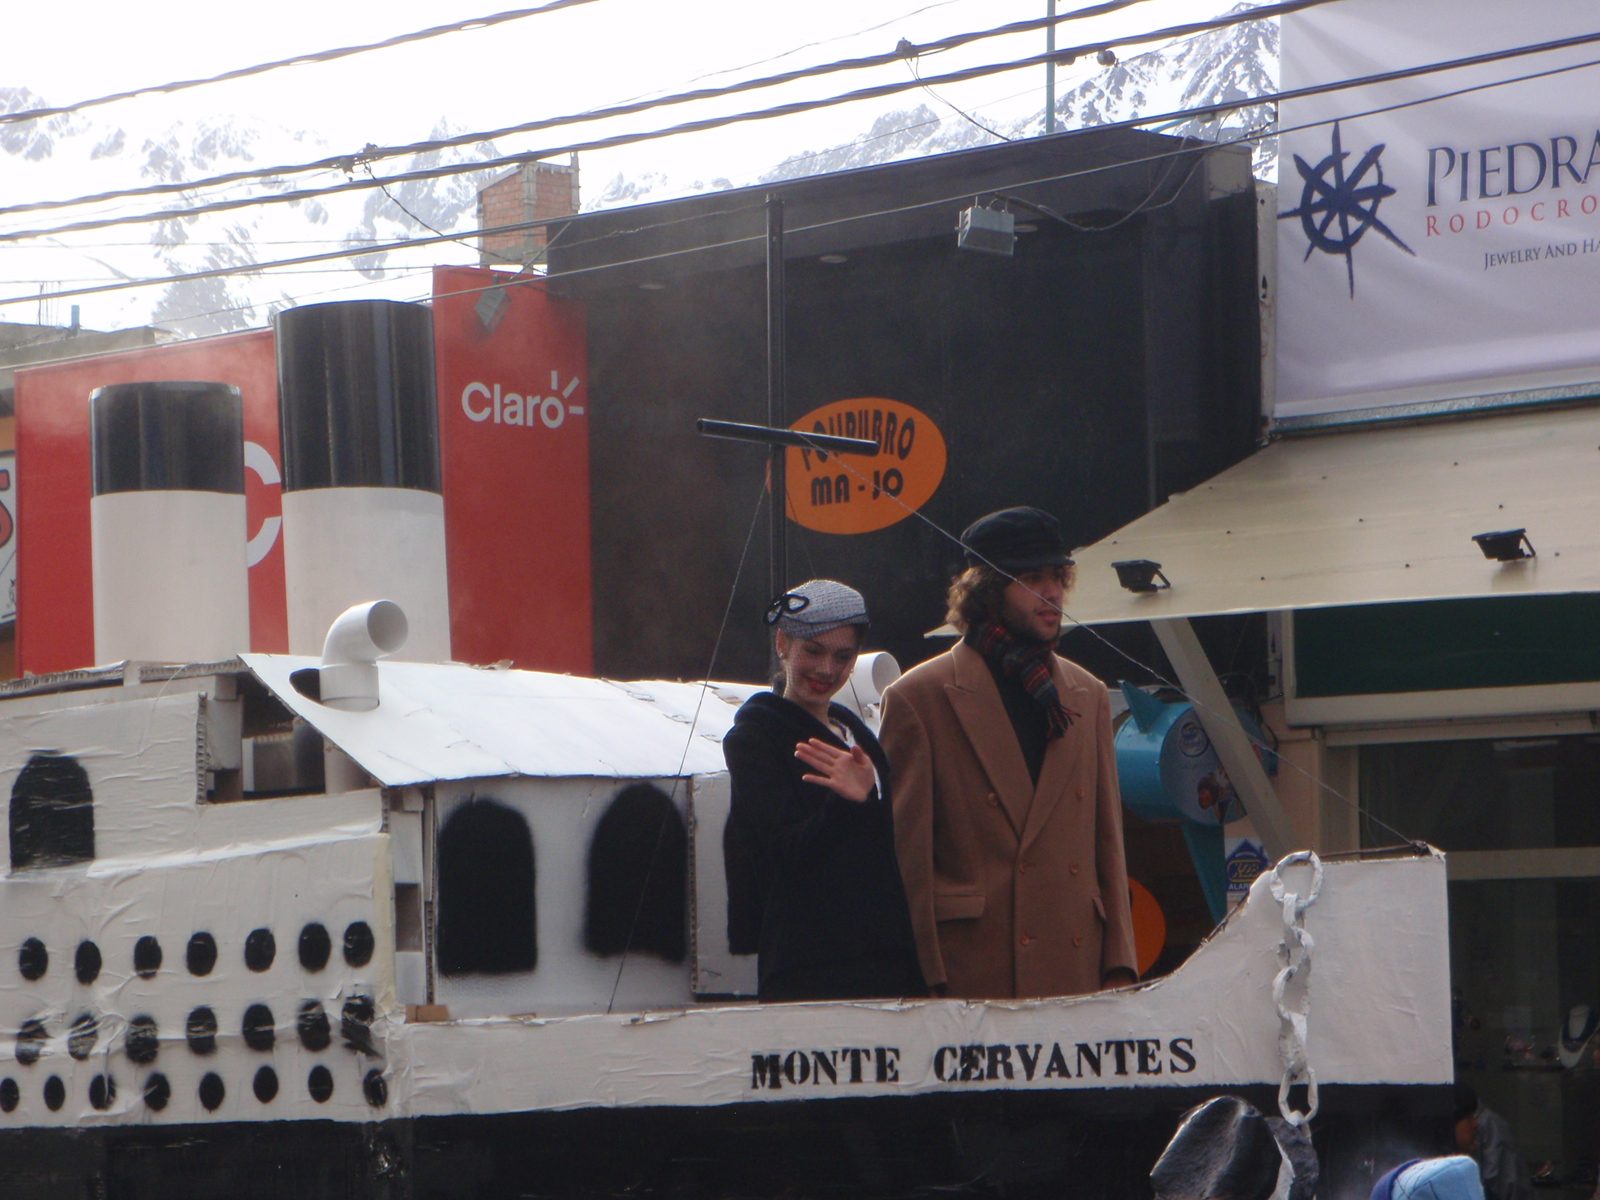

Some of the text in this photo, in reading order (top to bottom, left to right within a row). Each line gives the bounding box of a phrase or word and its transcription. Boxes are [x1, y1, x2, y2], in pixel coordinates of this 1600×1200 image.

[1426, 195, 1598, 237] RODOCRO
[1484, 247, 1541, 271] JEWELRY
[1544, 243, 1577, 260] AND
[461, 381, 565, 429] Claro
[751, 1038, 1198, 1090] MONTE CERVANTES
